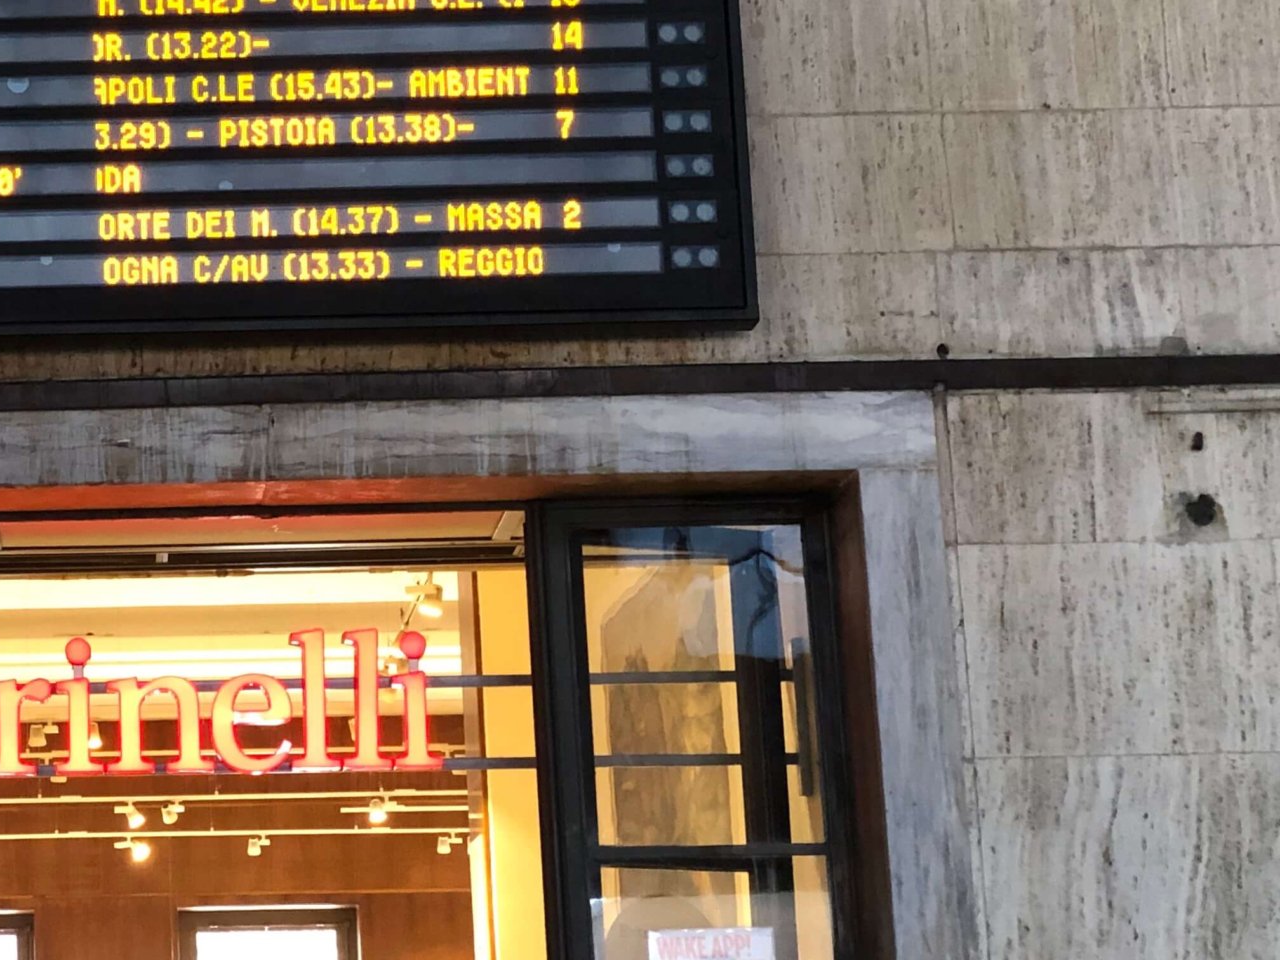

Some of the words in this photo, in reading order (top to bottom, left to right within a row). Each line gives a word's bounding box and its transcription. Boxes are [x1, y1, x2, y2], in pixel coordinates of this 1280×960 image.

[552, 21, 583, 50] 14
[192, 74, 255, 102] C.LE
[409, 67, 530, 98] AMBIENT
[554, 67, 579, 94] 11
[220, 116, 336, 147] PISTOIA
[556, 110, 574, 139] 7
[99, 211, 171, 240] ORTE
[186, 210, 236, 239] DEI
[251, 209, 278, 237] M.
[293, 206, 399, 236] (14.37)
[447, 201, 542, 231] MASSA
[563, 200, 581, 229] 2
[103, 255, 178, 285] OGNA
[283, 251, 390, 281] (13.33)
[439, 246, 543, 277] REGGIO
